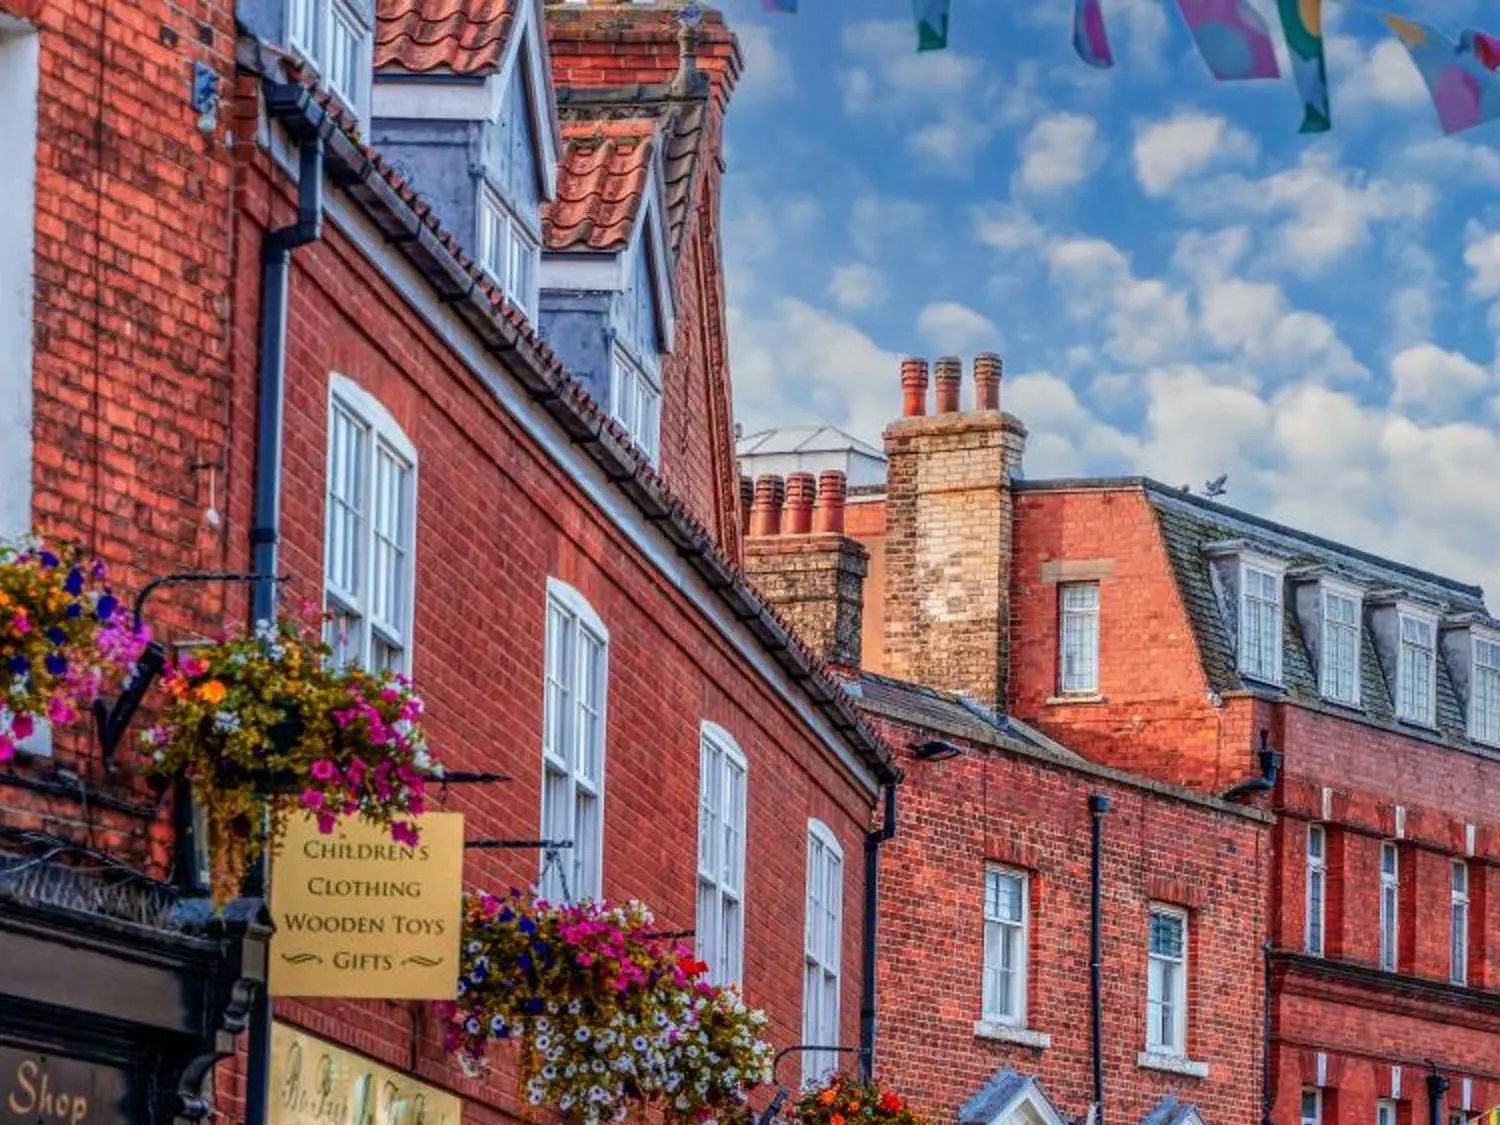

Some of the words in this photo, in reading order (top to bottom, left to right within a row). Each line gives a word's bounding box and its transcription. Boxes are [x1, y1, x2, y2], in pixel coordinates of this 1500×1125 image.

[303, 840, 430, 862] CHILDRENS
[307, 877, 423, 898] CLOTHING
[284, 913, 385, 934] WOODEN
[391, 915, 446, 935] TOYS
[332, 951, 394, 971] GIFTS
